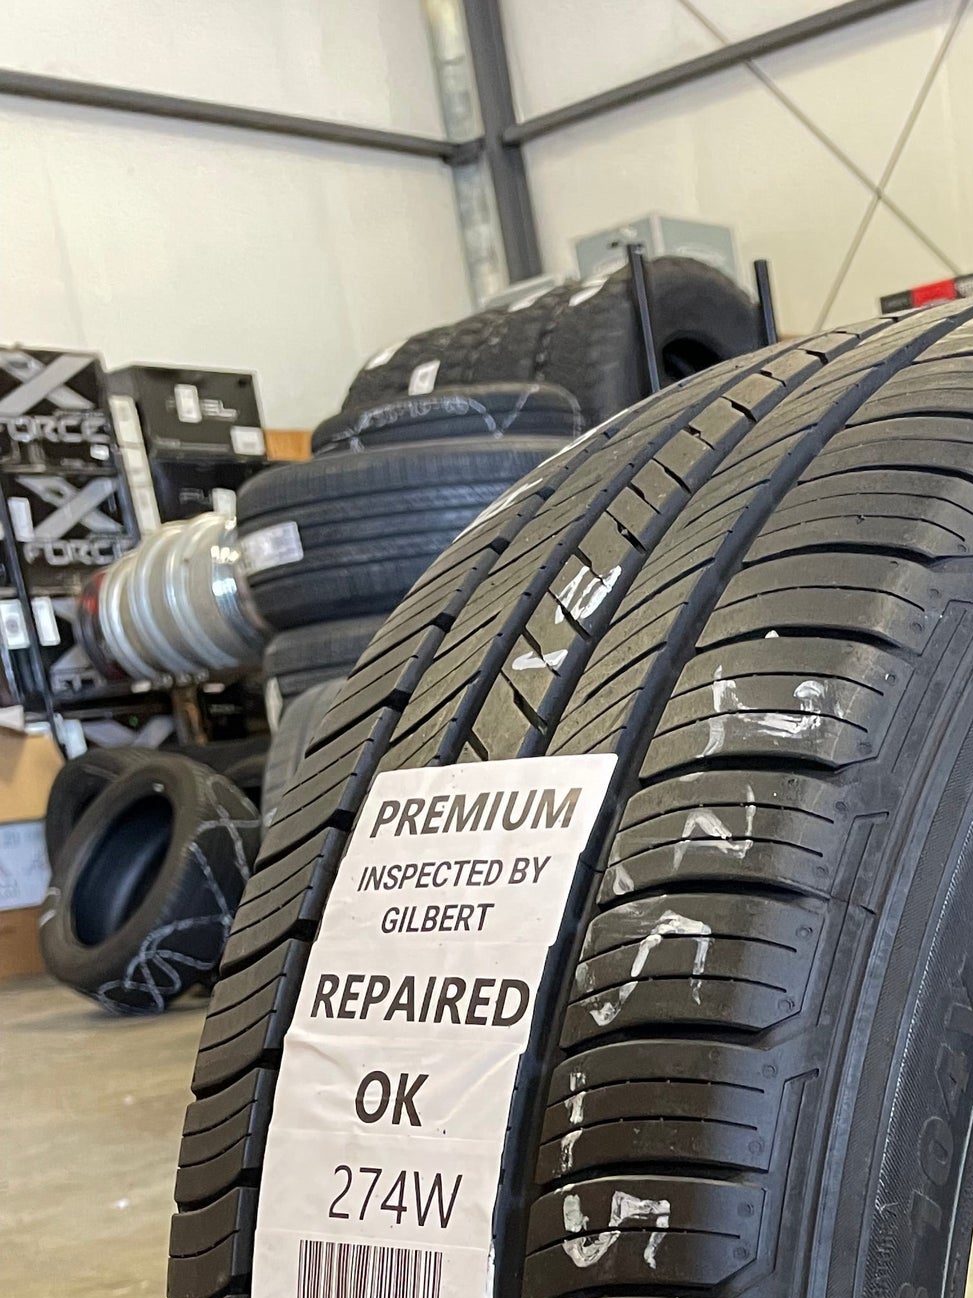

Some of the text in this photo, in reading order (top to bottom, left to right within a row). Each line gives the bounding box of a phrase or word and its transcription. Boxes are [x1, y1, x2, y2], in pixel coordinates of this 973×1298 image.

[0, 411, 111, 443] ORCE
[370, 788, 582, 838] PREMIUM
[357, 856, 551, 892] INSPECTED BY
[381, 903, 494, 934] GILBERT
[310, 973, 531, 1027] REPAIRED
[354, 1070, 429, 1128] OK
[328, 1164, 463, 1229] 274W
